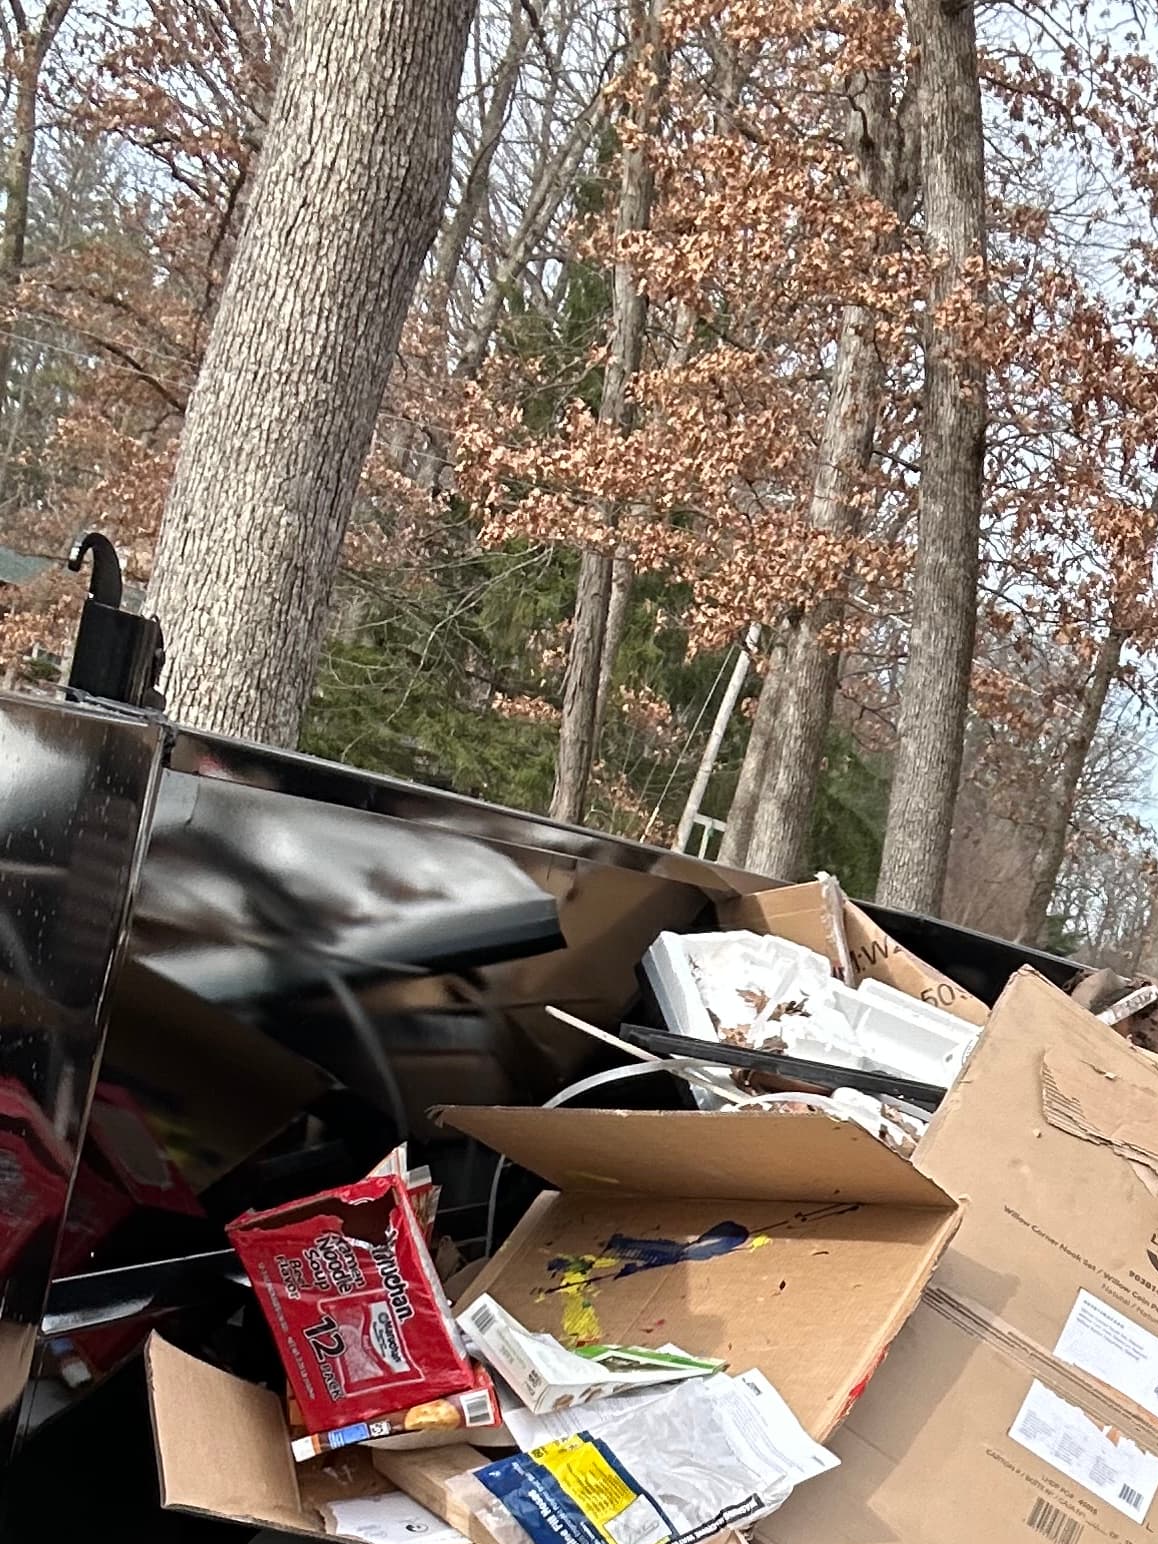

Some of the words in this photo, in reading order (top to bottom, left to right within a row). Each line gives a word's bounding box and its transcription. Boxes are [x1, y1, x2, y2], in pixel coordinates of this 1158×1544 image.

[274, 1254, 300, 1301] Flavor
[303, 1246, 331, 1292] Soup
[315, 1233, 355, 1297] Noodle
[1029, 1223, 1060, 1247] Corner
[1058, 1243, 1083, 1262] Nook
[1101, 1271, 1131, 1293] Willow
[1130, 1290, 1152, 1306] Coin
[301, 1314, 346, 1364] 12
[319, 1361, 343, 1401] PACK
[525, 1486, 554, 1518] Hoses
[545, 1513, 565, 1534] Fill
